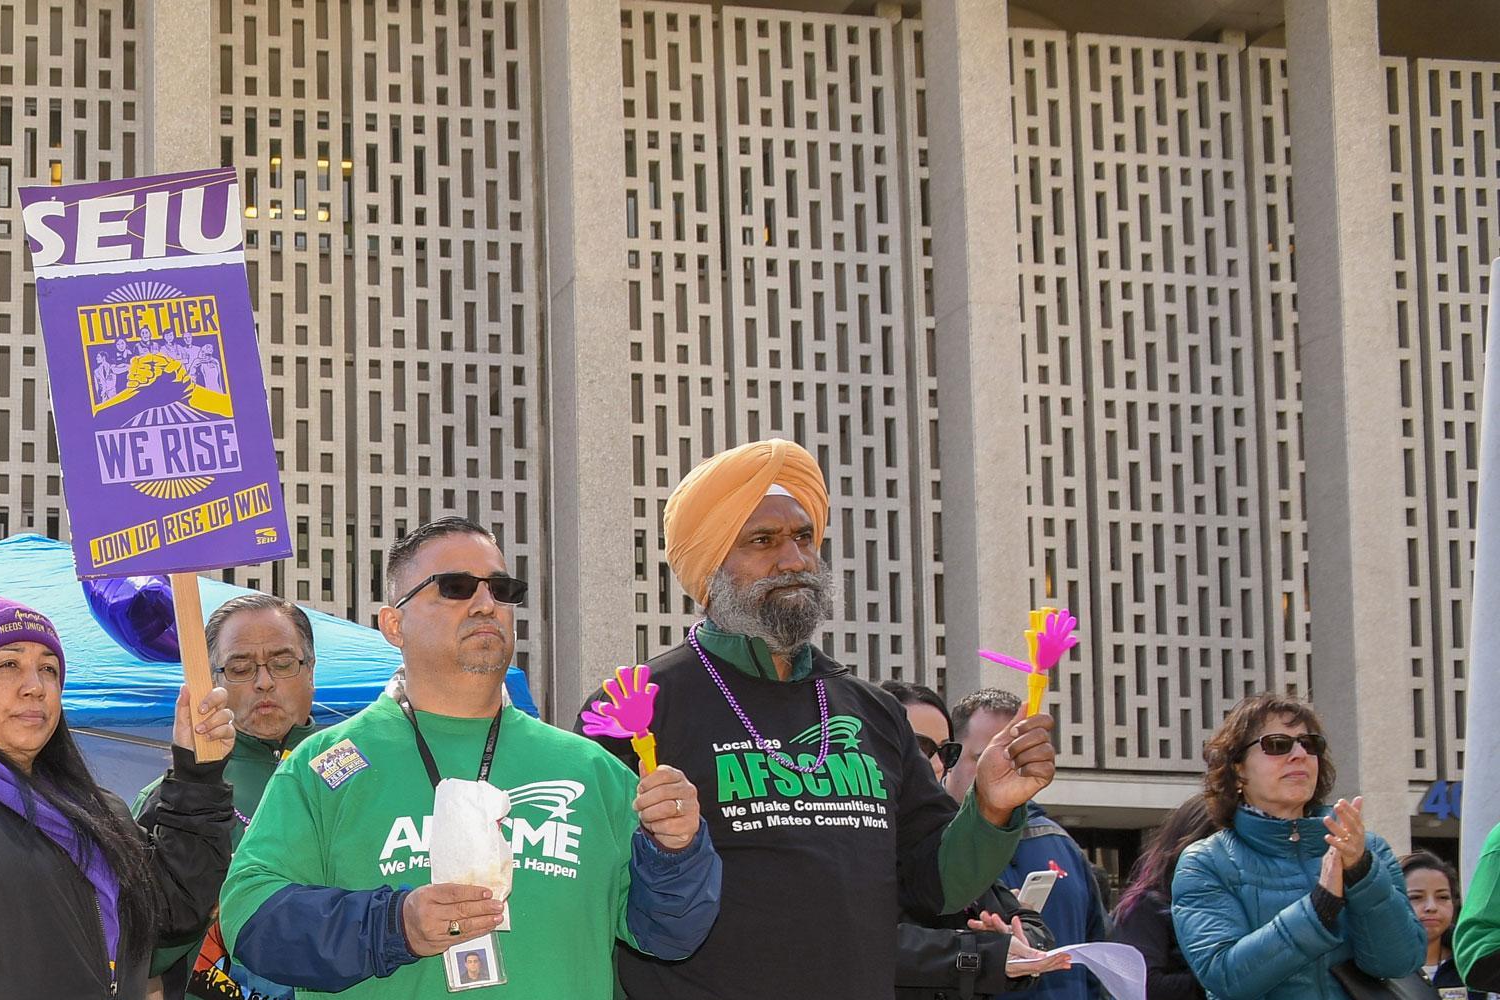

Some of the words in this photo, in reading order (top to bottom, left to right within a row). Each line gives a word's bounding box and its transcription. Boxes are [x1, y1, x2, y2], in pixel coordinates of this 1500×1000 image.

[22, 184, 243, 267] SEIU
[81, 301, 216, 343] TOGETHER
[97, 430, 149, 480] WE
[164, 424, 239, 476] RISE
[93, 529, 133, 566] JOIN
[135, 522, 158, 554] UP
[164, 505, 206, 543] RISE
[208, 498, 231, 529] UP
[237, 486, 271, 519] WIN
[256, 536, 277, 545] SEIU
[0, 621, 23, 634] NEEDS
[712, 740, 753, 752] Local
[715, 752, 887, 802] AFSCME
[721, 806, 747, 818] We
[750, 801, 791, 814] Make
[794, 800, 875, 813] Communities
[732, 820, 763, 832] San
[767, 815, 811, 827] Mateo
[814, 815, 860, 828] County
[862, 816, 888, 829] Work
[379, 860, 406, 876] We
[409, 855, 431, 869] Ma
[525, 858, 577, 879] Happen
